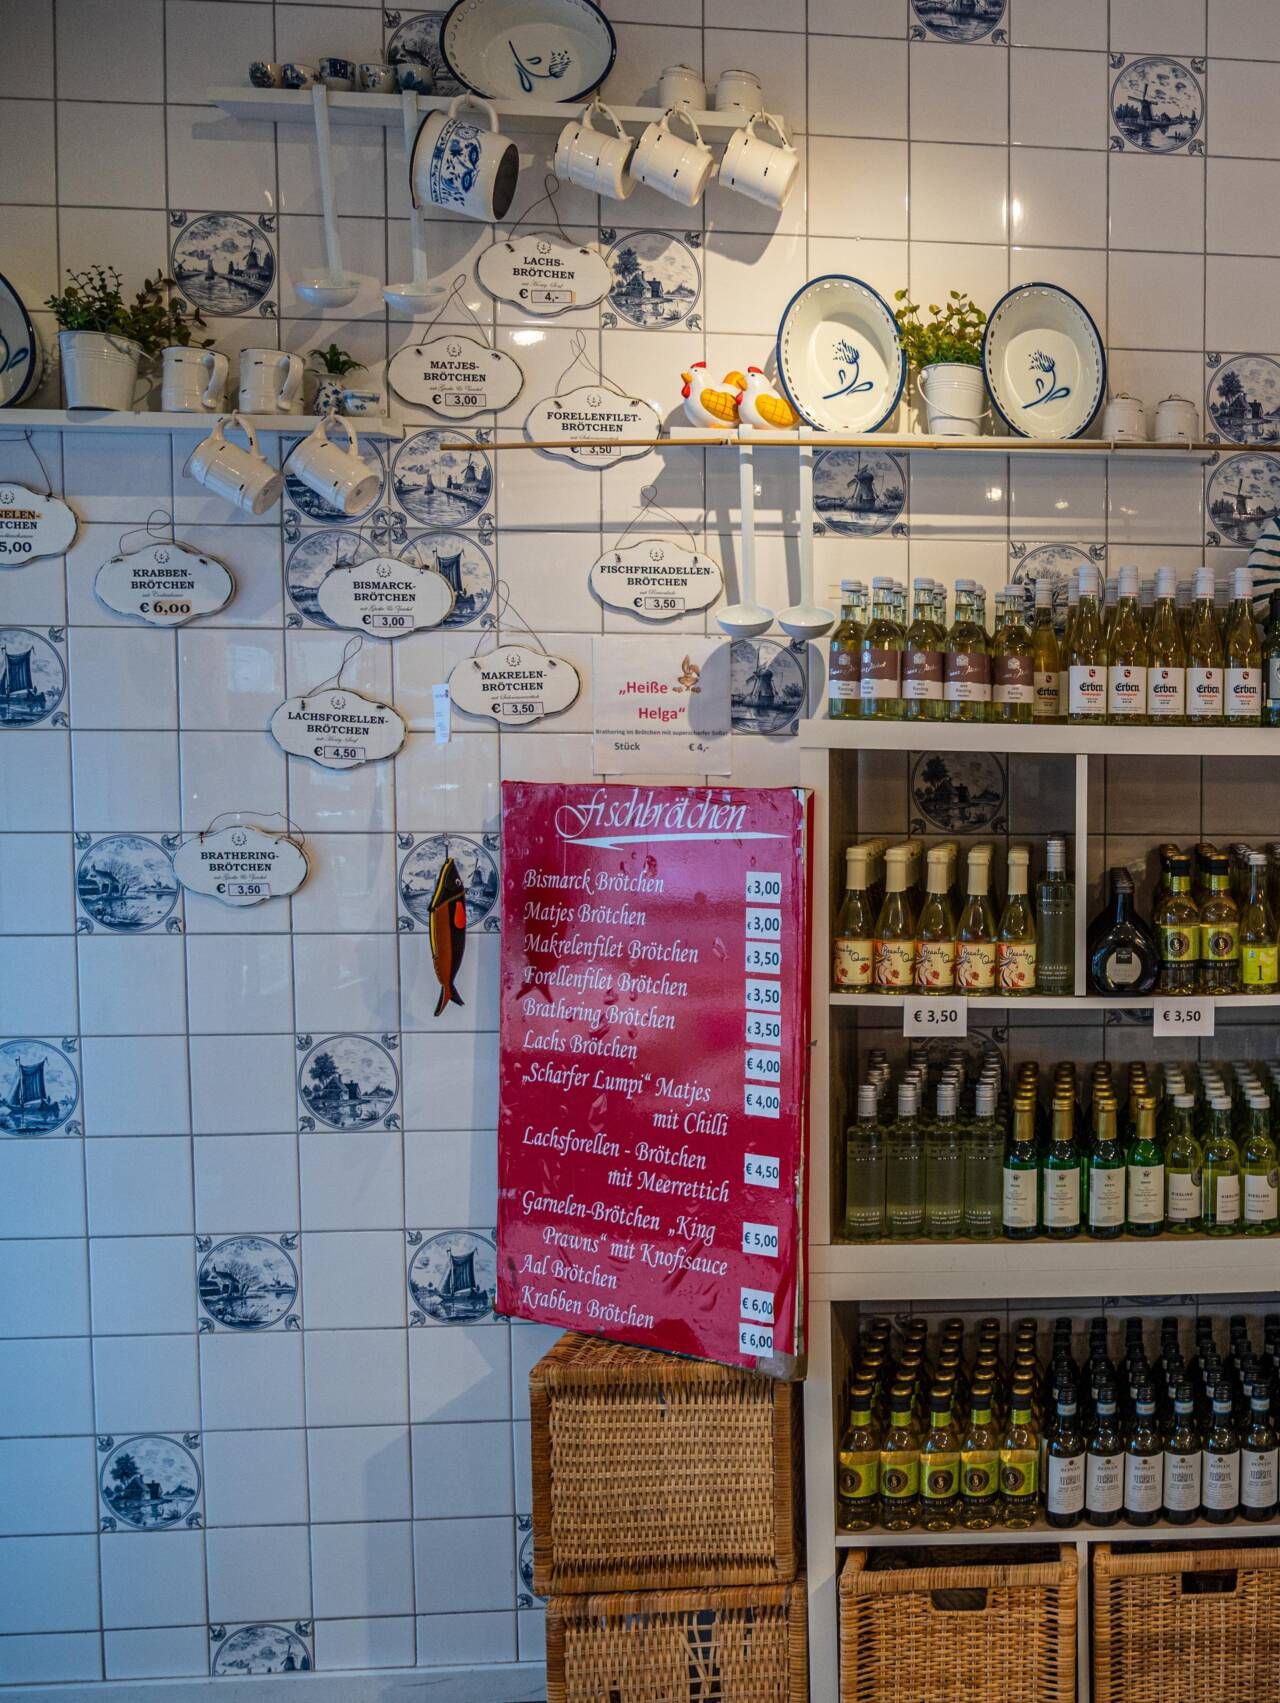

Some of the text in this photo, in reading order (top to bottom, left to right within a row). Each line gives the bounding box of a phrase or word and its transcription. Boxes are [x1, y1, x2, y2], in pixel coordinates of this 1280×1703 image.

[523, 257, 565, 267] LACHS-
[512, 266, 576, 280] BRÖTCHEN
[519, 288, 560, 302] € 4,-
[430, 360, 480, 371] MATJES-
[423, 370, 487, 383] BRÖTCHEN
[432, 394, 477, 406] € 3,00
[546, 411, 642, 423] FORELLENFILET-
[561, 421, 623, 433] BRÖTCHEN
[589, 445, 612, 454] 3,50
[0, 541, 32, 555] 5,00
[132, 568, 192, 578] KRABBEN-
[600, 565, 715, 577] FISCHFRIKADELLEN-
[131, 578, 195, 589] BRÖTCHEN
[353, 580, 417, 591] BISMARCK-
[626, 575, 688, 587] BRÖTCHEN
[353, 591, 416, 602] BRÖTCHEN
[633, 597, 676, 609] € 3,50
[140, 601, 191, 615] € 6,00
[362, 614, 405, 627] € 3,00
[481, 670, 548, 681] MAKRELEN-
[481, 681, 544, 692] BRÖTCHEN
[618, 680, 668, 696] „Heiße
[1079, 682, 1104, 692] Erben
[1115, 682, 1140, 692] Erben
[1153, 683, 1177, 694] Erben
[1196, 683, 1220, 694] Erben
[1233, 683, 1257, 694] Erben
[491, 703, 535, 715] € 3,50
[638, 707, 686, 722] Helga“
[287, 711, 389, 725] LACHSFORELLEN-
[306, 723, 370, 736] BRÖTCHEN
[314, 746, 357, 760] € 4,50
[614, 742, 710, 752] Stück € 4,-
[200, 851, 280, 861] BRATHERING-
[208, 861, 272, 872] BRÖTCHEN
[523, 868, 665, 895] Bismarck Brötchen
[754, 880, 780, 896] 3,00
[216, 883, 261, 896] € 3,50
[523, 901, 647, 929] Matjes Brötchen
[754, 916, 780, 932] 3,00
[523, 933, 699, 964] Makrelenfilet Brötchen
[753, 950, 779, 966] 3,50
[523, 965, 689, 997] Forellenfilet Brötchen
[753, 988, 780, 1005] 3,50
[522, 997, 675, 1030] Brathering Brötchen
[913, 1009, 958, 1024] € 3,50
[1163, 1010, 1201, 1024] € 3,50
[754, 1022, 780, 1039] 3,50
[522, 1029, 638, 1060] Lachs Brötchen
[746, 1059, 780, 1075] € 4,00
[521, 1061, 712, 1105] „Scharfer Lumpi“ Matjes
[745, 1094, 780, 1112] € 4,00
[653, 1108, 729, 1137] mit Chilli
[522, 1126, 621, 1158] Lachsforellen
[634, 1141, 707, 1171] Brötchen
[745, 1162, 780, 1180] € 4,50
[607, 1168, 730, 1203] mit Meerrettich
[521, 1190, 717, 1247] Garnelen-Brötchen „King
[744, 1232, 778, 1249] € 5,00
[542, 1225, 729, 1277] Prawns“ mit Knofisauce
[519, 1253, 618, 1290] Aal Brötchen
[519, 1284, 656, 1329] Krabben Brötchen
[741, 1297, 774, 1316] € 6,00
[740, 1332, 773, 1350] € 6,00
